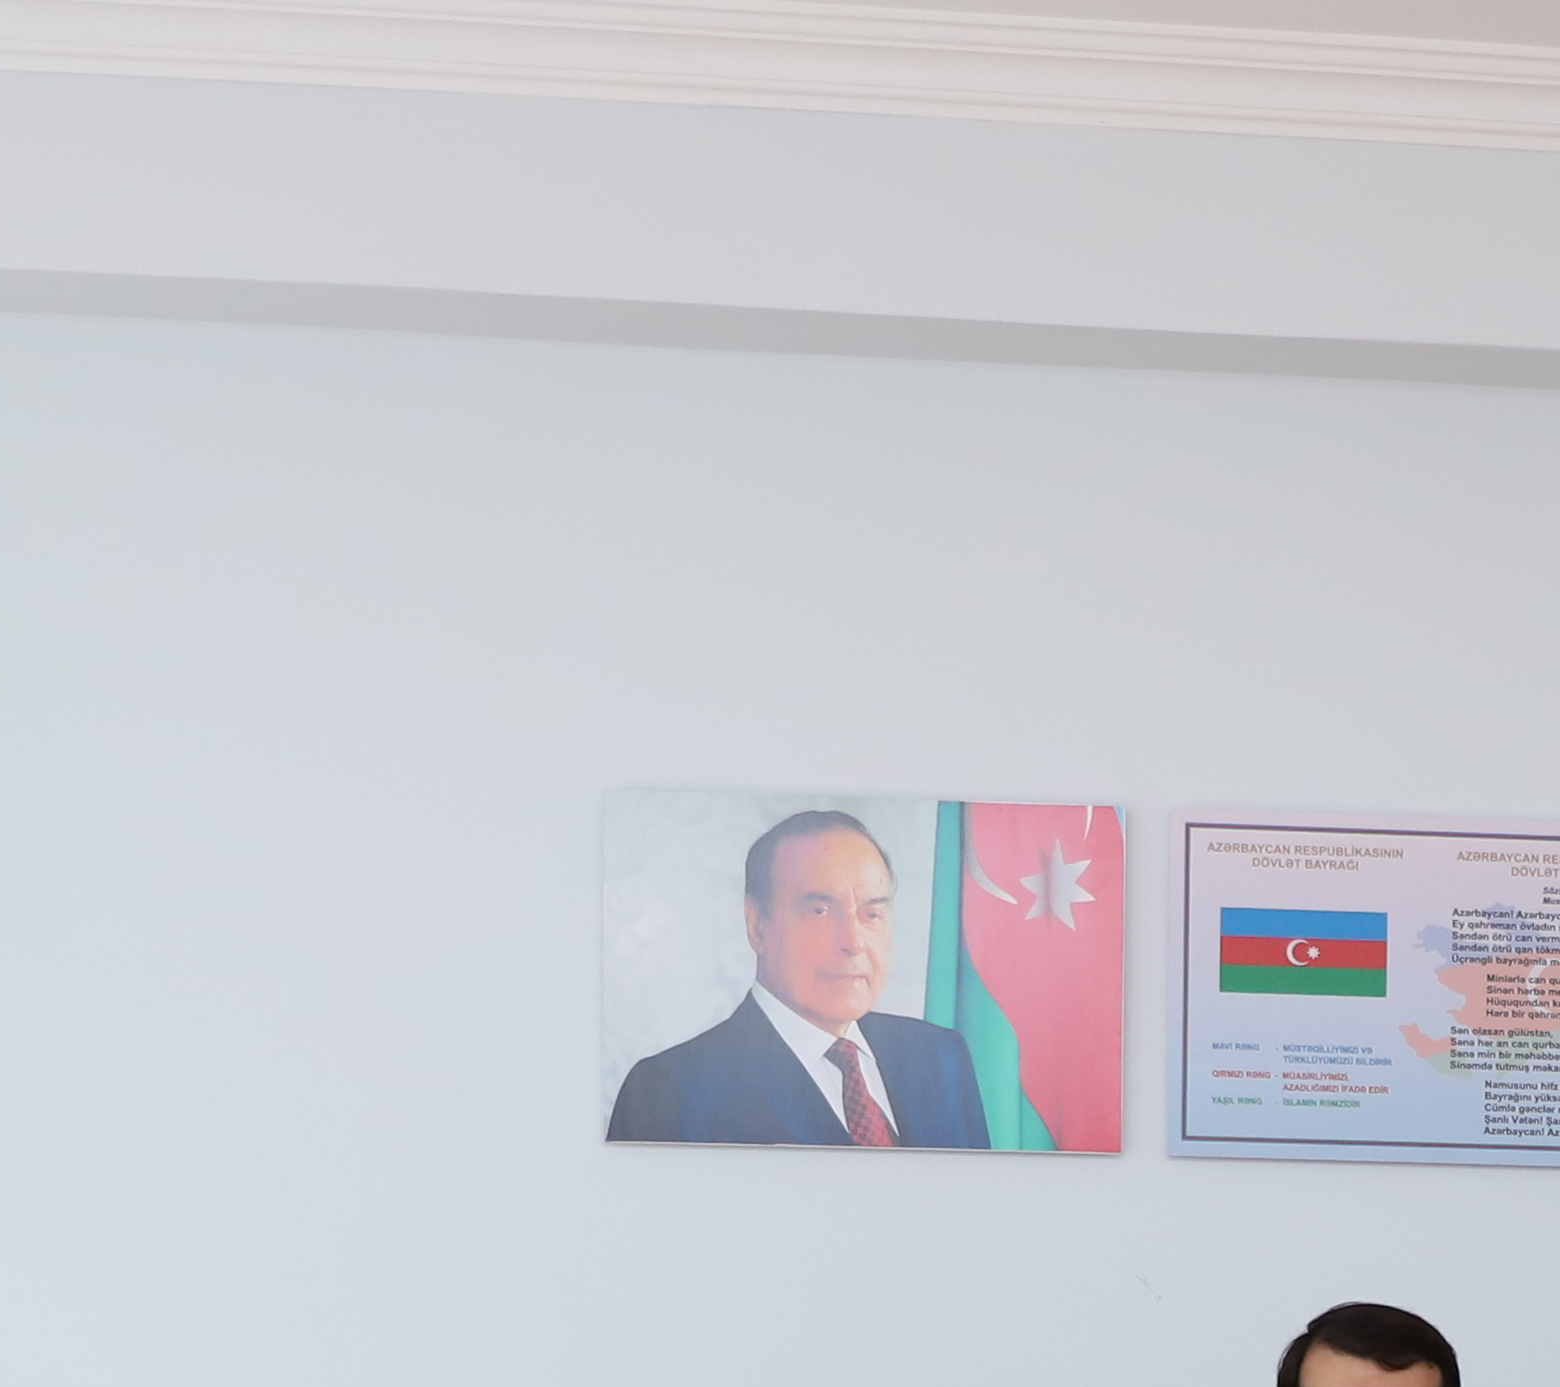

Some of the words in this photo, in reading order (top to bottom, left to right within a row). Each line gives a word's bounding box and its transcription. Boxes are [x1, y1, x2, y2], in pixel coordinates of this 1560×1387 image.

[1207, 842, 1290, 854] AZƏRBAYCAN
[1294, 845, 1403, 859] RESPUBLİKASININ
[1457, 852, 1539, 864] AZƏRBAYCAN
[1252, 857, 1302, 868] DÖVLƏT
[1305, 859, 1359, 871] BAYRAĞI
[1511, 866, 1559, 878] DÖVLƏT
[1452, 908, 1513, 920] Azərbaycan!
[1452, 920, 1464, 930] Ey
[1468, 921, 1517, 932] qəhrəman
[1520, 922, 1555, 931] övladın
[1452, 932, 1488, 941] Səndən
[1492, 933, 1512, 942] ötrü
[1452, 943, 1488, 953] Səndən
[1492, 944, 1512, 953] ötrü
[1515, 946, 1533, 955] qan
[1452, 954, 1493, 966] Üçrəngli
[1496, 956, 1547, 968] bayrağınla
[1487, 974, 1525, 984] Minlərlə
[1487, 986, 1514, 995] Sinən
[1517, 987, 1545, 996] hərbə
[1487, 997, 1549, 1009] Hüququndan
[1486, 1009, 1509, 1018] Hərə
[1512, 1010, 1525, 1018] bir
[1451, 1027, 1469, 1035] Sən
[1472, 1027, 1504, 1036] olasan
[1212, 1042, 1232, 1050] MAVİ
[1450, 1037, 1474, 1047] Sənə
[1478, 1039, 1493, 1047] hər
[1450, 1049, 1474, 1058] Sənə
[1478, 1050, 1496, 1059] min
[1499, 1051, 1512, 1059] bir
[1450, 1061, 1492, 1070] Sinəmdə
[1496, 1062, 1529, 1072] tutmuş
[1485, 1081, 1538, 1091] Namusunu
[1541, 1082, 1558, 1091] hifz
[1485, 1092, 1531, 1103] Bayrağını
[1485, 1103, 1515, 1113] Cümlə
[1519, 1105, 1554, 1115] gənclər
[1484, 1115, 1509, 1125] Şanlı
[1512, 1116, 1543, 1125] Vətən!
[1484, 1127, 1544, 1138] Azərbaycan!
